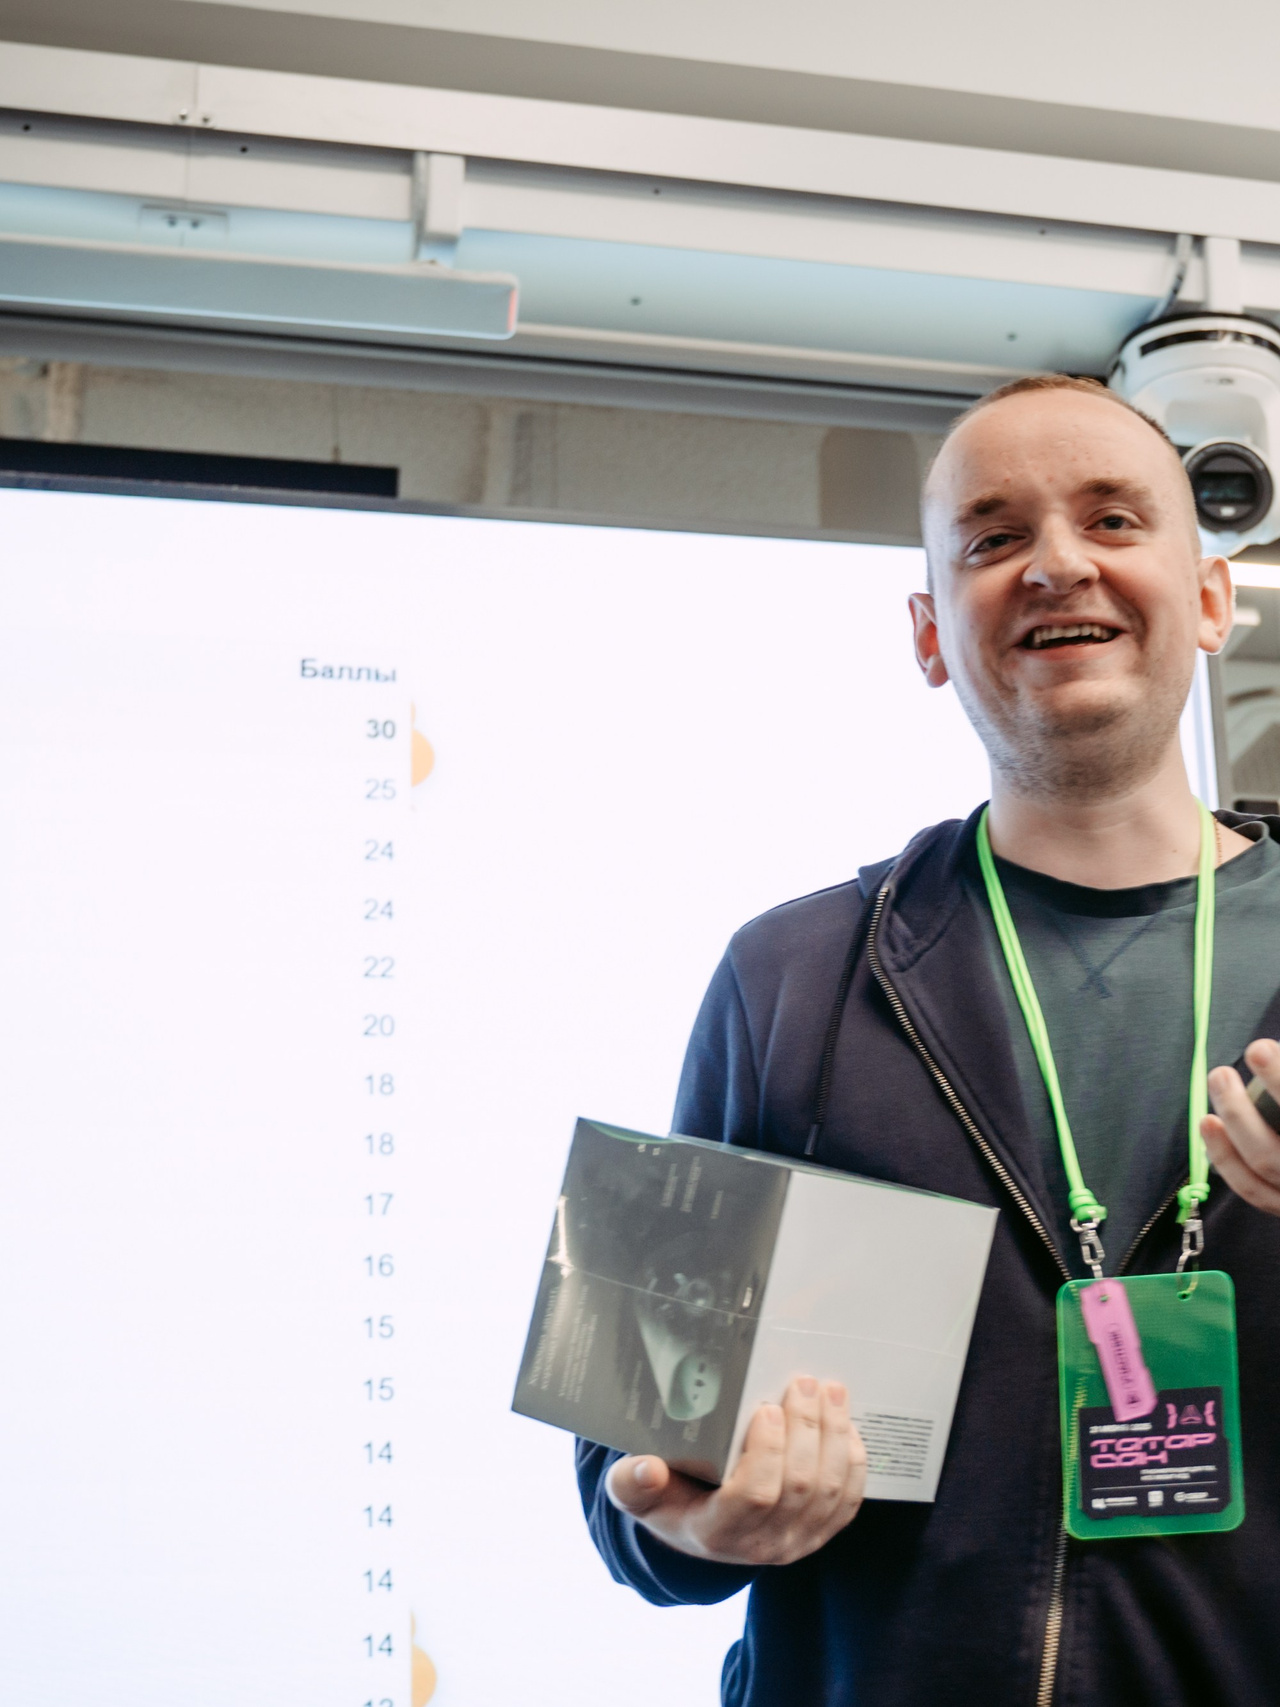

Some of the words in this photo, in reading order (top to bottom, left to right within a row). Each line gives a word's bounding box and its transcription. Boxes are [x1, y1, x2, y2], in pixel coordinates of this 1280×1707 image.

[300, 658, 396, 682] Баллы
[366, 718, 396, 740] 30
[365, 779, 396, 801] 25
[364, 840, 394, 861] 24
[364, 899, 394, 921] 24
[363, 956, 395, 979] 22
[363, 1014, 395, 1037] 20
[365, 1073, 394, 1096] 18
[365, 1132, 394, 1156] 18
[364, 1192, 394, 1216] 17
[364, 1253, 395, 1277] 16
[364, 1315, 394, 1339] 15
[363, 1377, 395, 1402] 15
[363, 1440, 394, 1464] 14
[363, 1504, 394, 1528] 14
[363, 1568, 394, 1593] 14
[362, 1632, 395, 1659] 14
